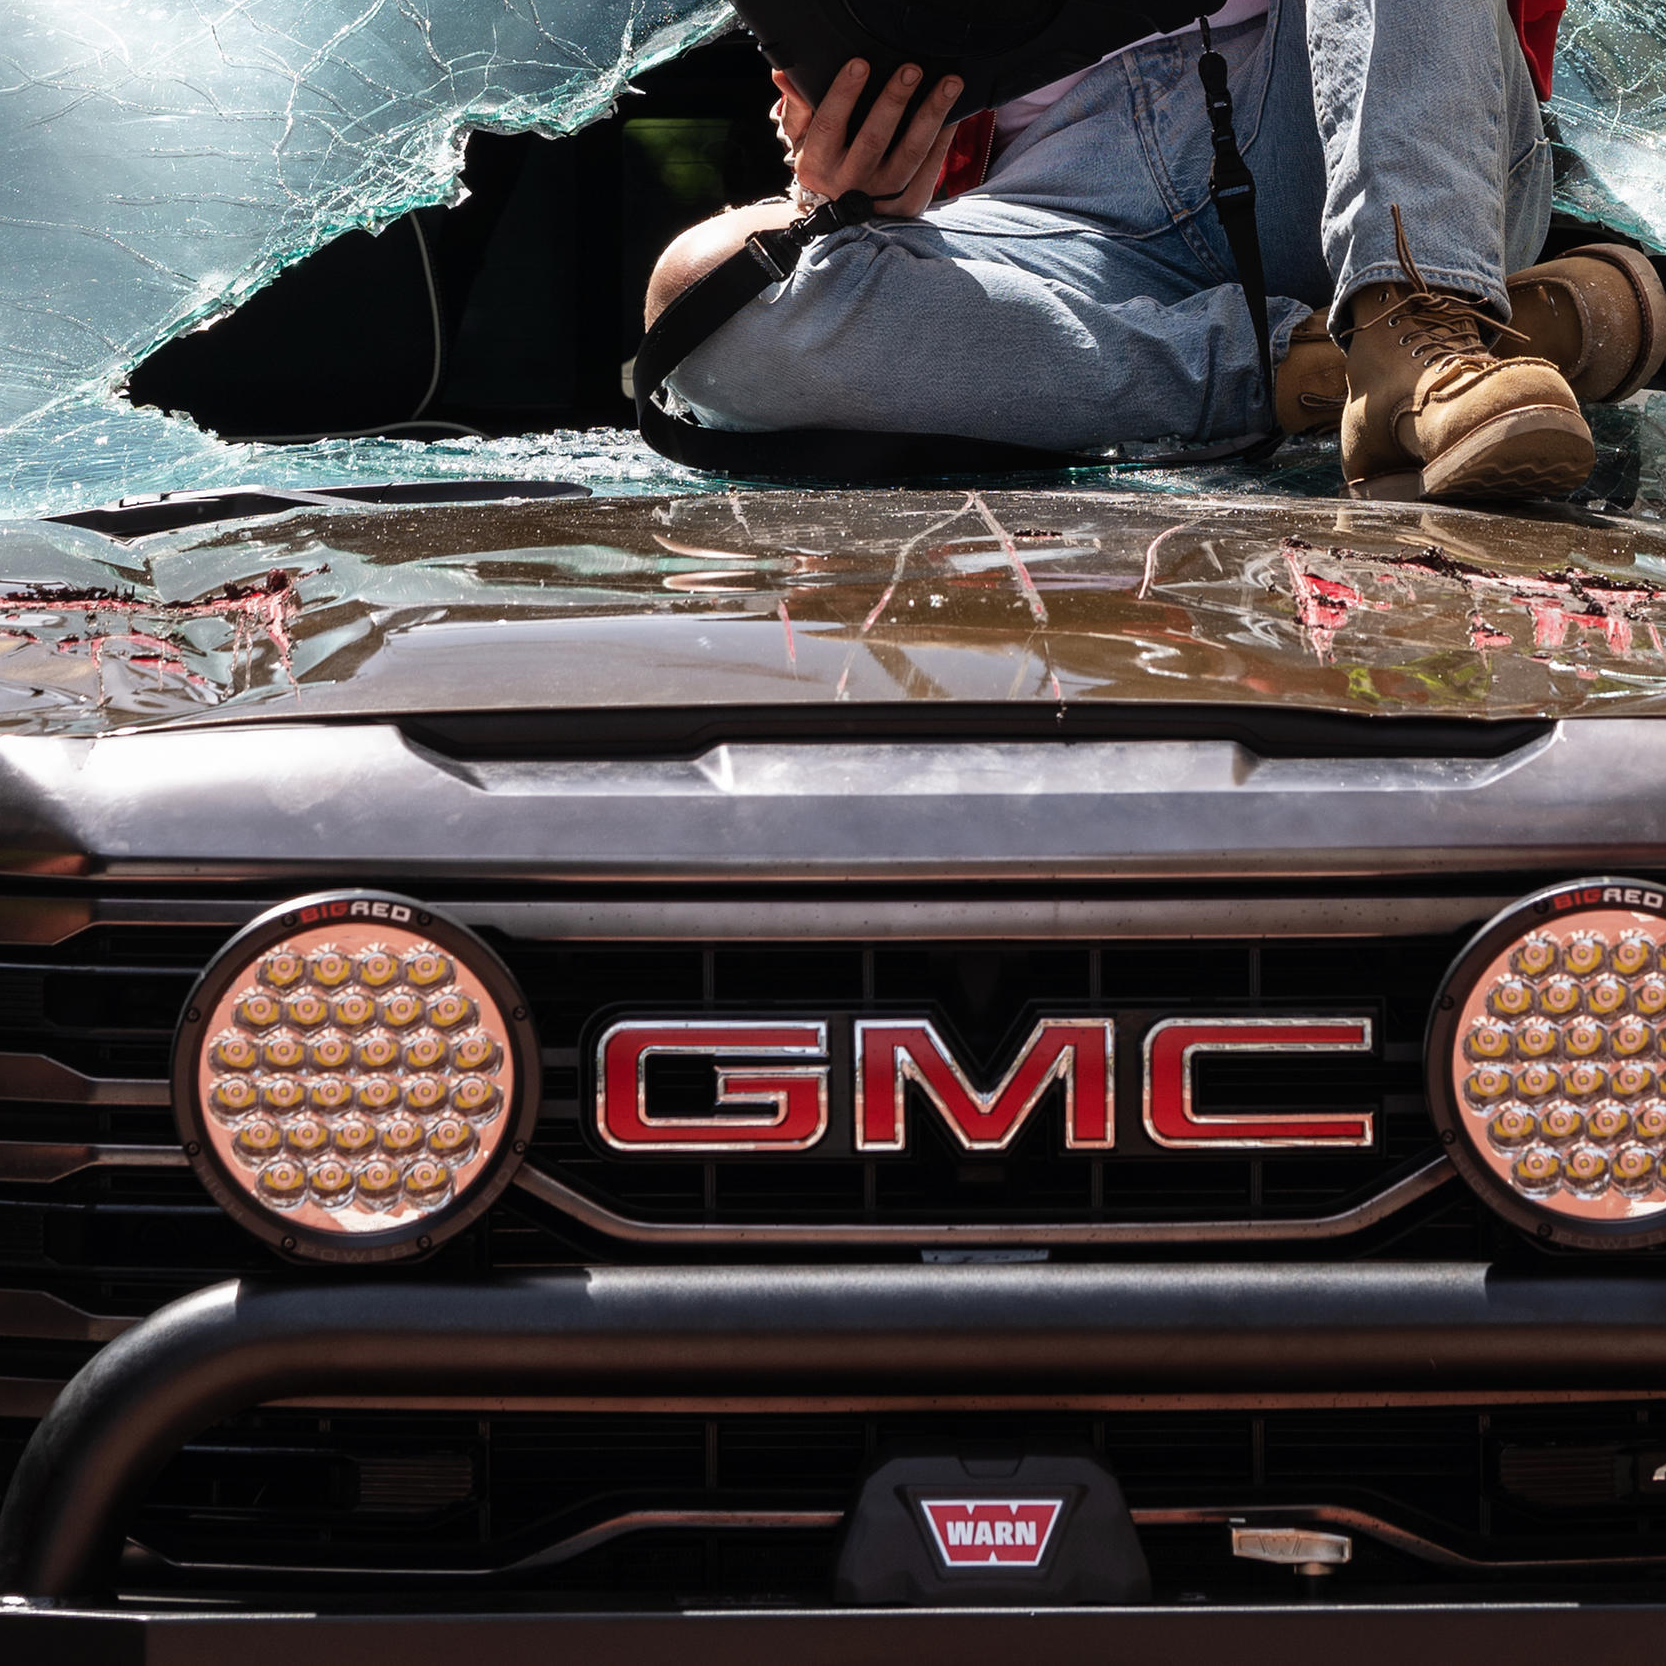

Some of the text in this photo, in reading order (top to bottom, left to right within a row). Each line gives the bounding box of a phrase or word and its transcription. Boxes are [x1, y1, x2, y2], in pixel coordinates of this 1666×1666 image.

[596, 1018, 1374, 1152] GMC
[299, 1245, 407, 1262] POWER
[465, 1169, 511, 1216] LED
[1557, 1232, 1662, 1248] POWER
[946, 1521, 1037, 1546] WARN
